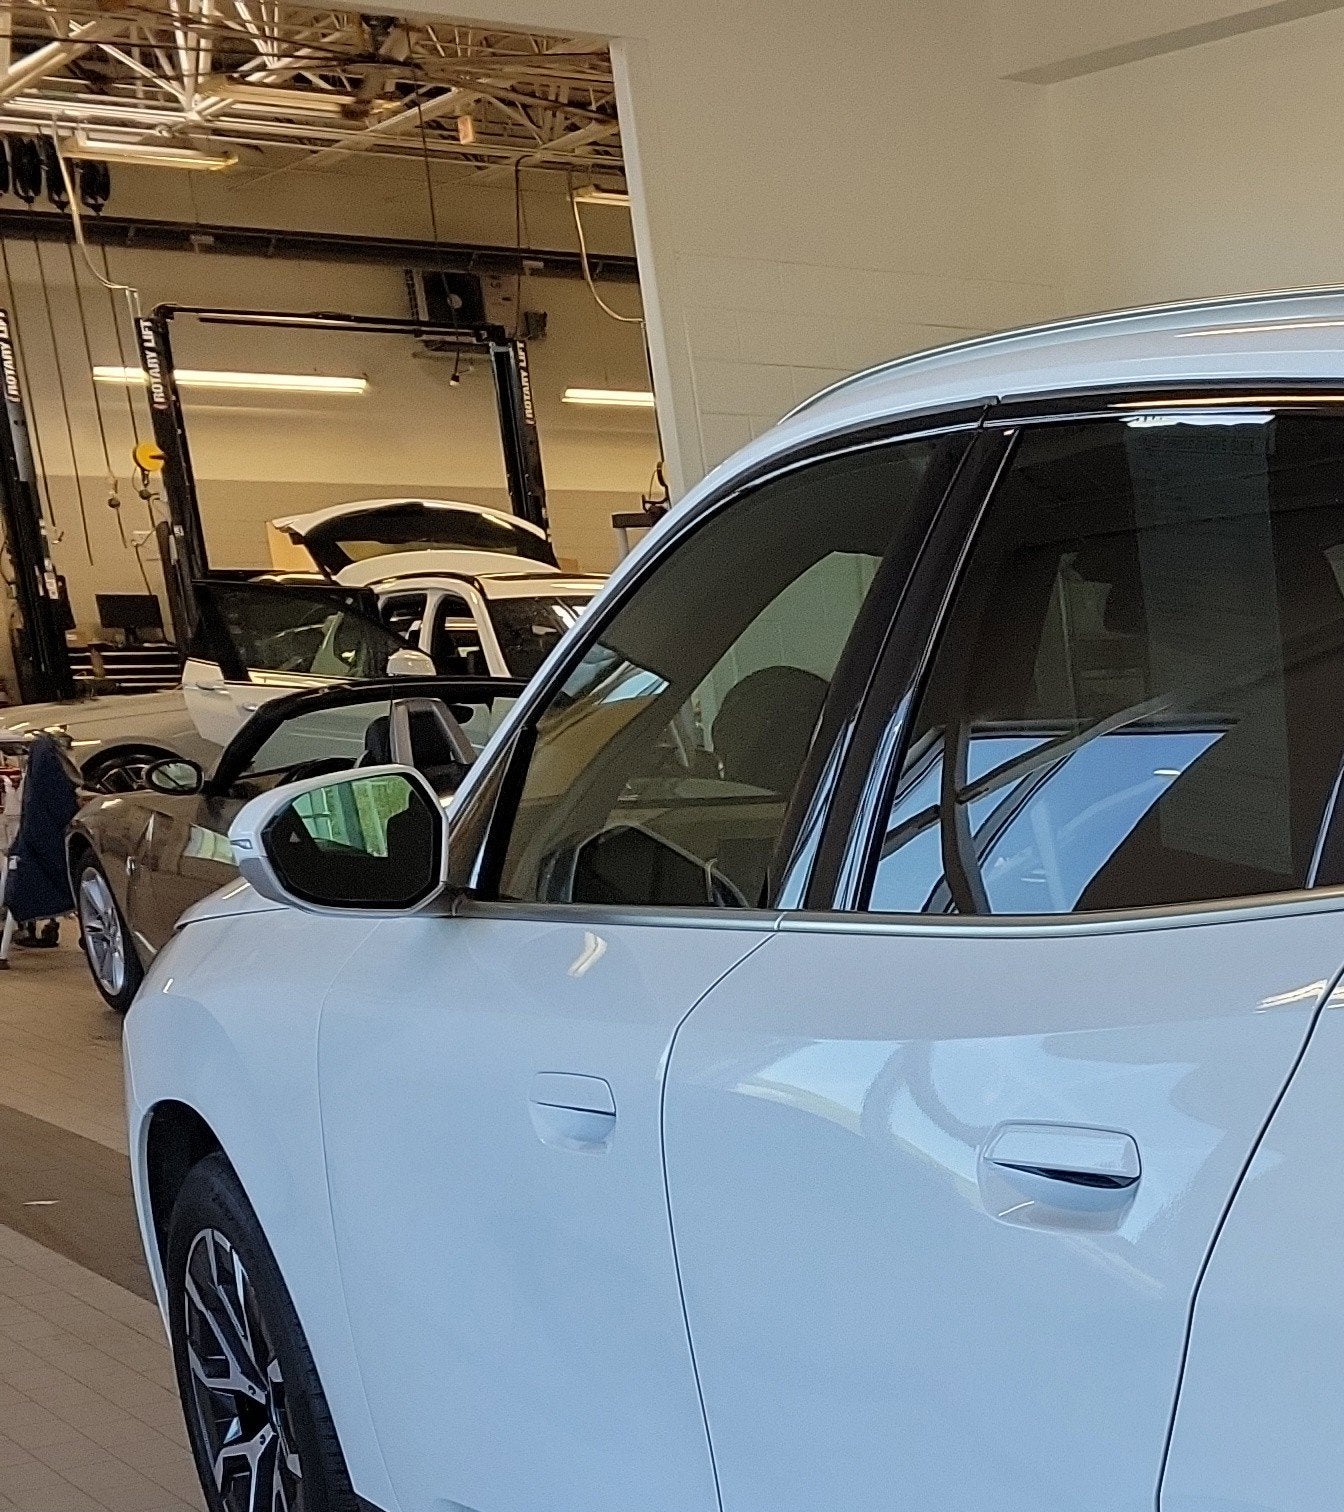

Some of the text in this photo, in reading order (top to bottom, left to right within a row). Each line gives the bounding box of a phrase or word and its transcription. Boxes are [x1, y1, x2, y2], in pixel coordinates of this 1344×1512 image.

[140, 319, 165, 403] ROTARY LIFT
[517, 340, 534, 419] ROTARY LIFT
